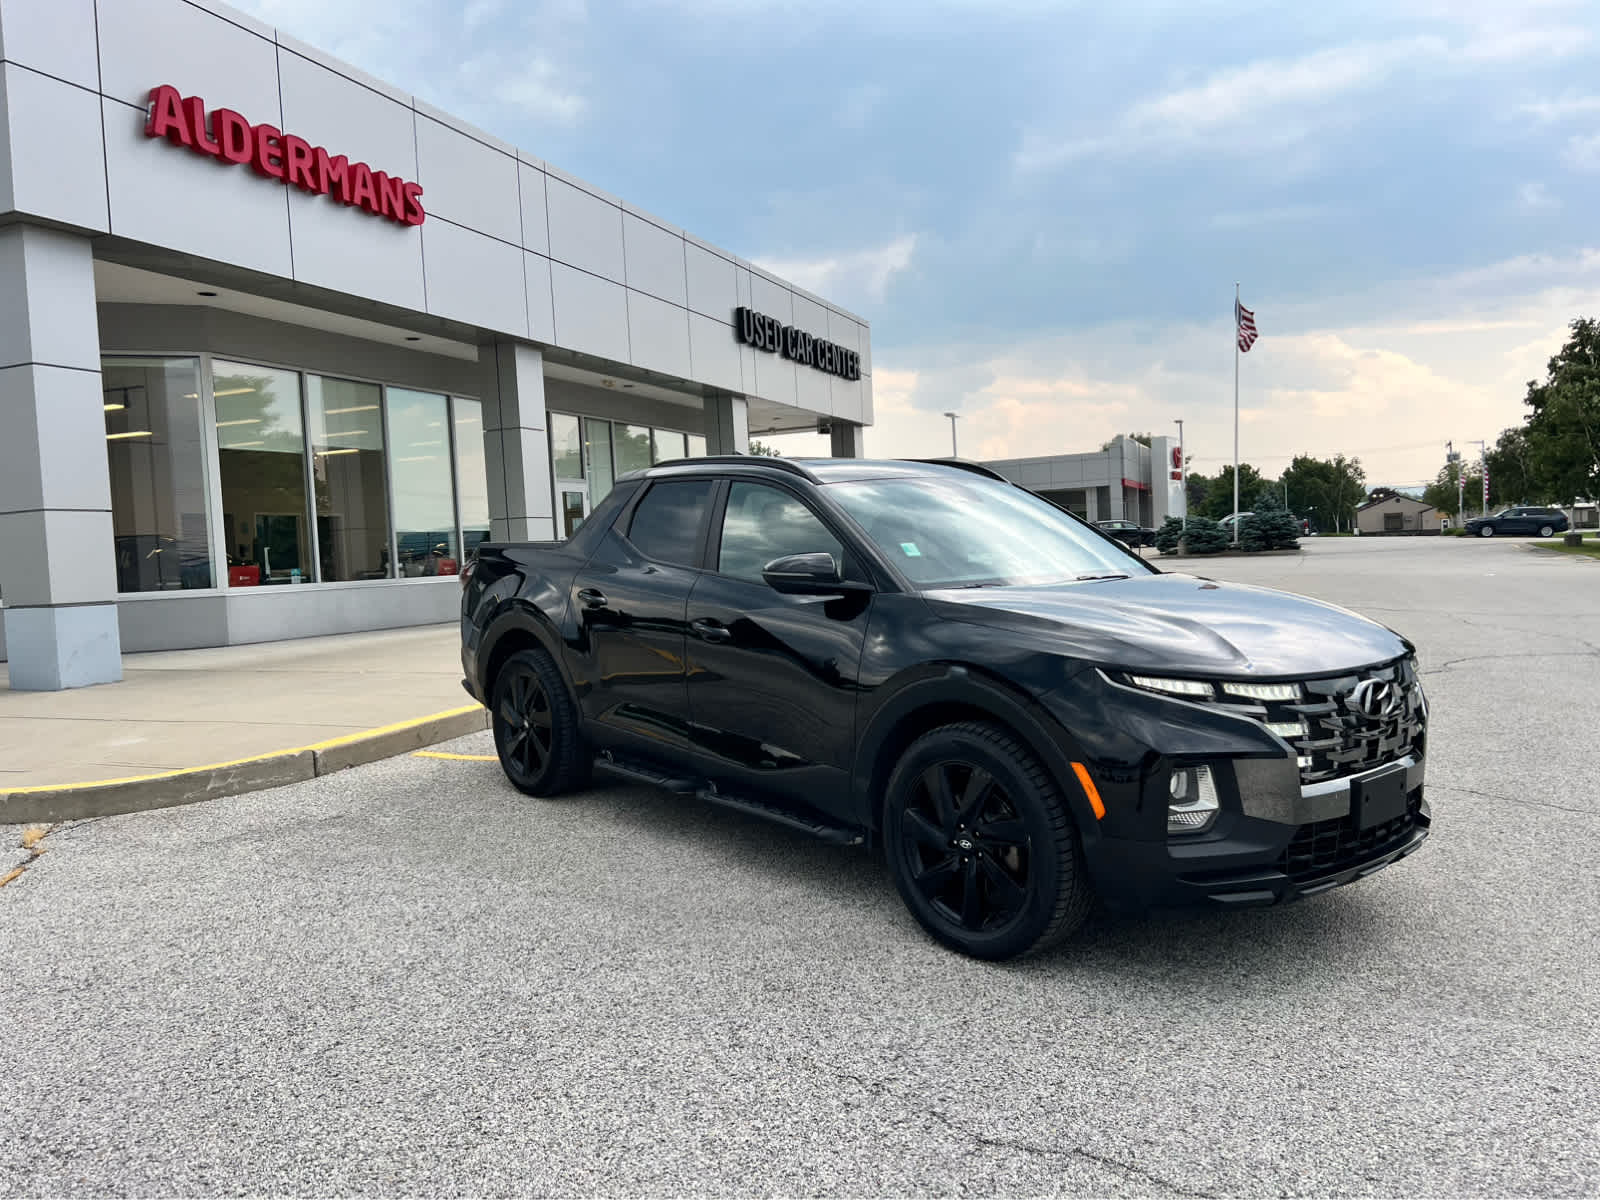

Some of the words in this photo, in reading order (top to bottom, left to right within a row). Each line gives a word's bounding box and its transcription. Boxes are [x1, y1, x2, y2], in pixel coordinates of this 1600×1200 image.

[146, 84, 425, 226] ALDERMANS
[737, 306, 783, 353] USED
[784, 325, 815, 364] CAR
[814, 338, 861, 380] CENTER
